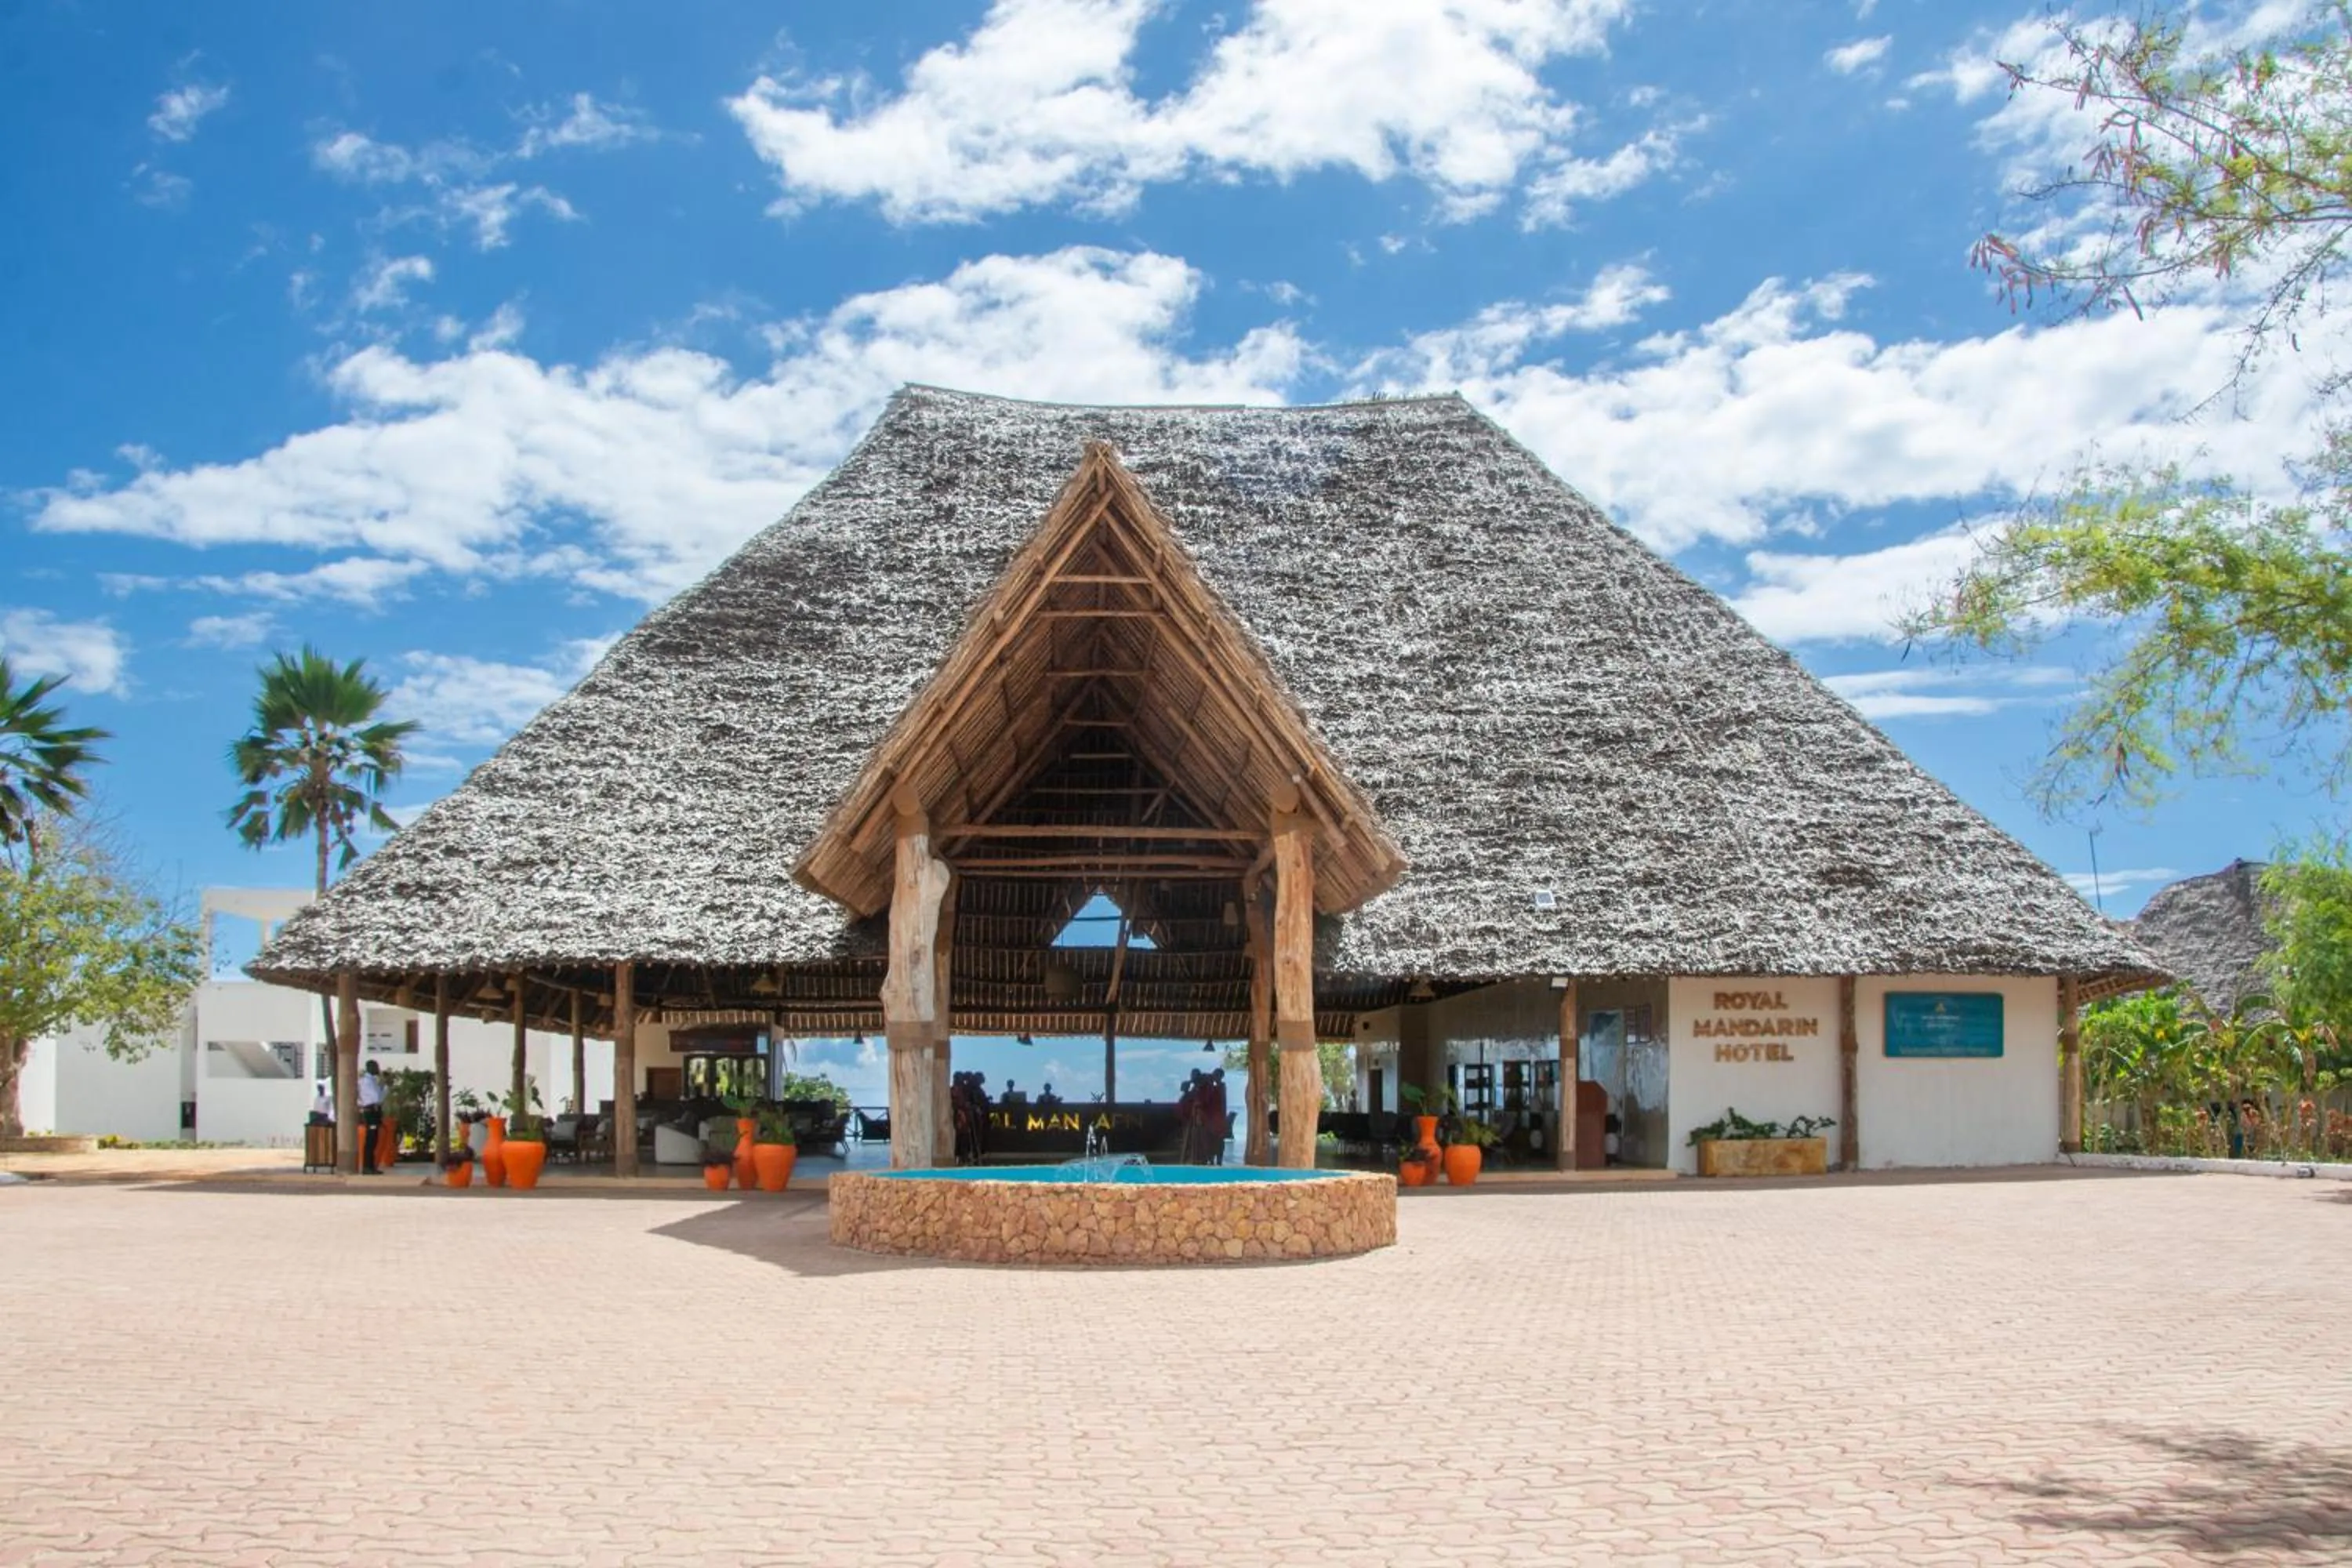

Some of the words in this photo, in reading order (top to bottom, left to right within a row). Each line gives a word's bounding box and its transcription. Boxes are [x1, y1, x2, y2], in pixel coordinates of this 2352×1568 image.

[1714, 992, 1788, 1011] ROYAL
[1693, 1018, 1818, 1037] MANDARIN
[1714, 1044, 1795, 1062] HOTEL
